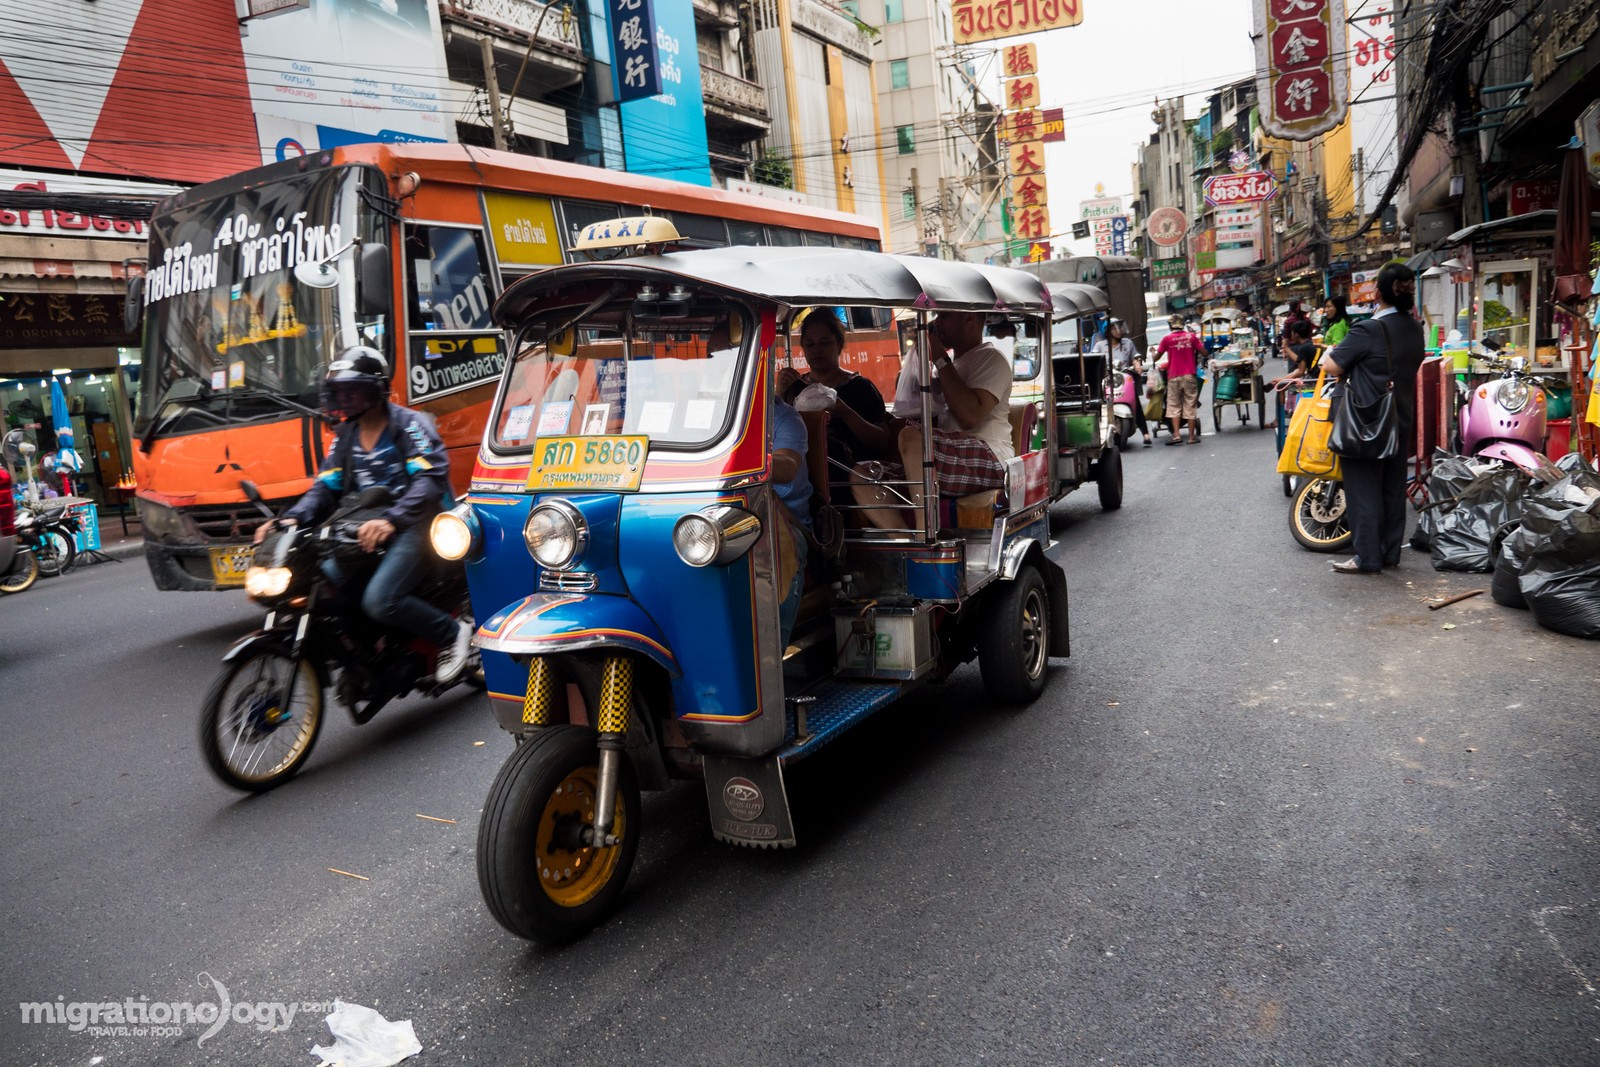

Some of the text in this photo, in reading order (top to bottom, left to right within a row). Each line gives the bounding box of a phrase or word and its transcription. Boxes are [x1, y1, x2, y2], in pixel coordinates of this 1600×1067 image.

[1211, 176, 1271, 201] ทองใบ
[543, 440, 642, 466] สก 5860
[541, 471, 622, 487] กรุงเทพมหานคร
